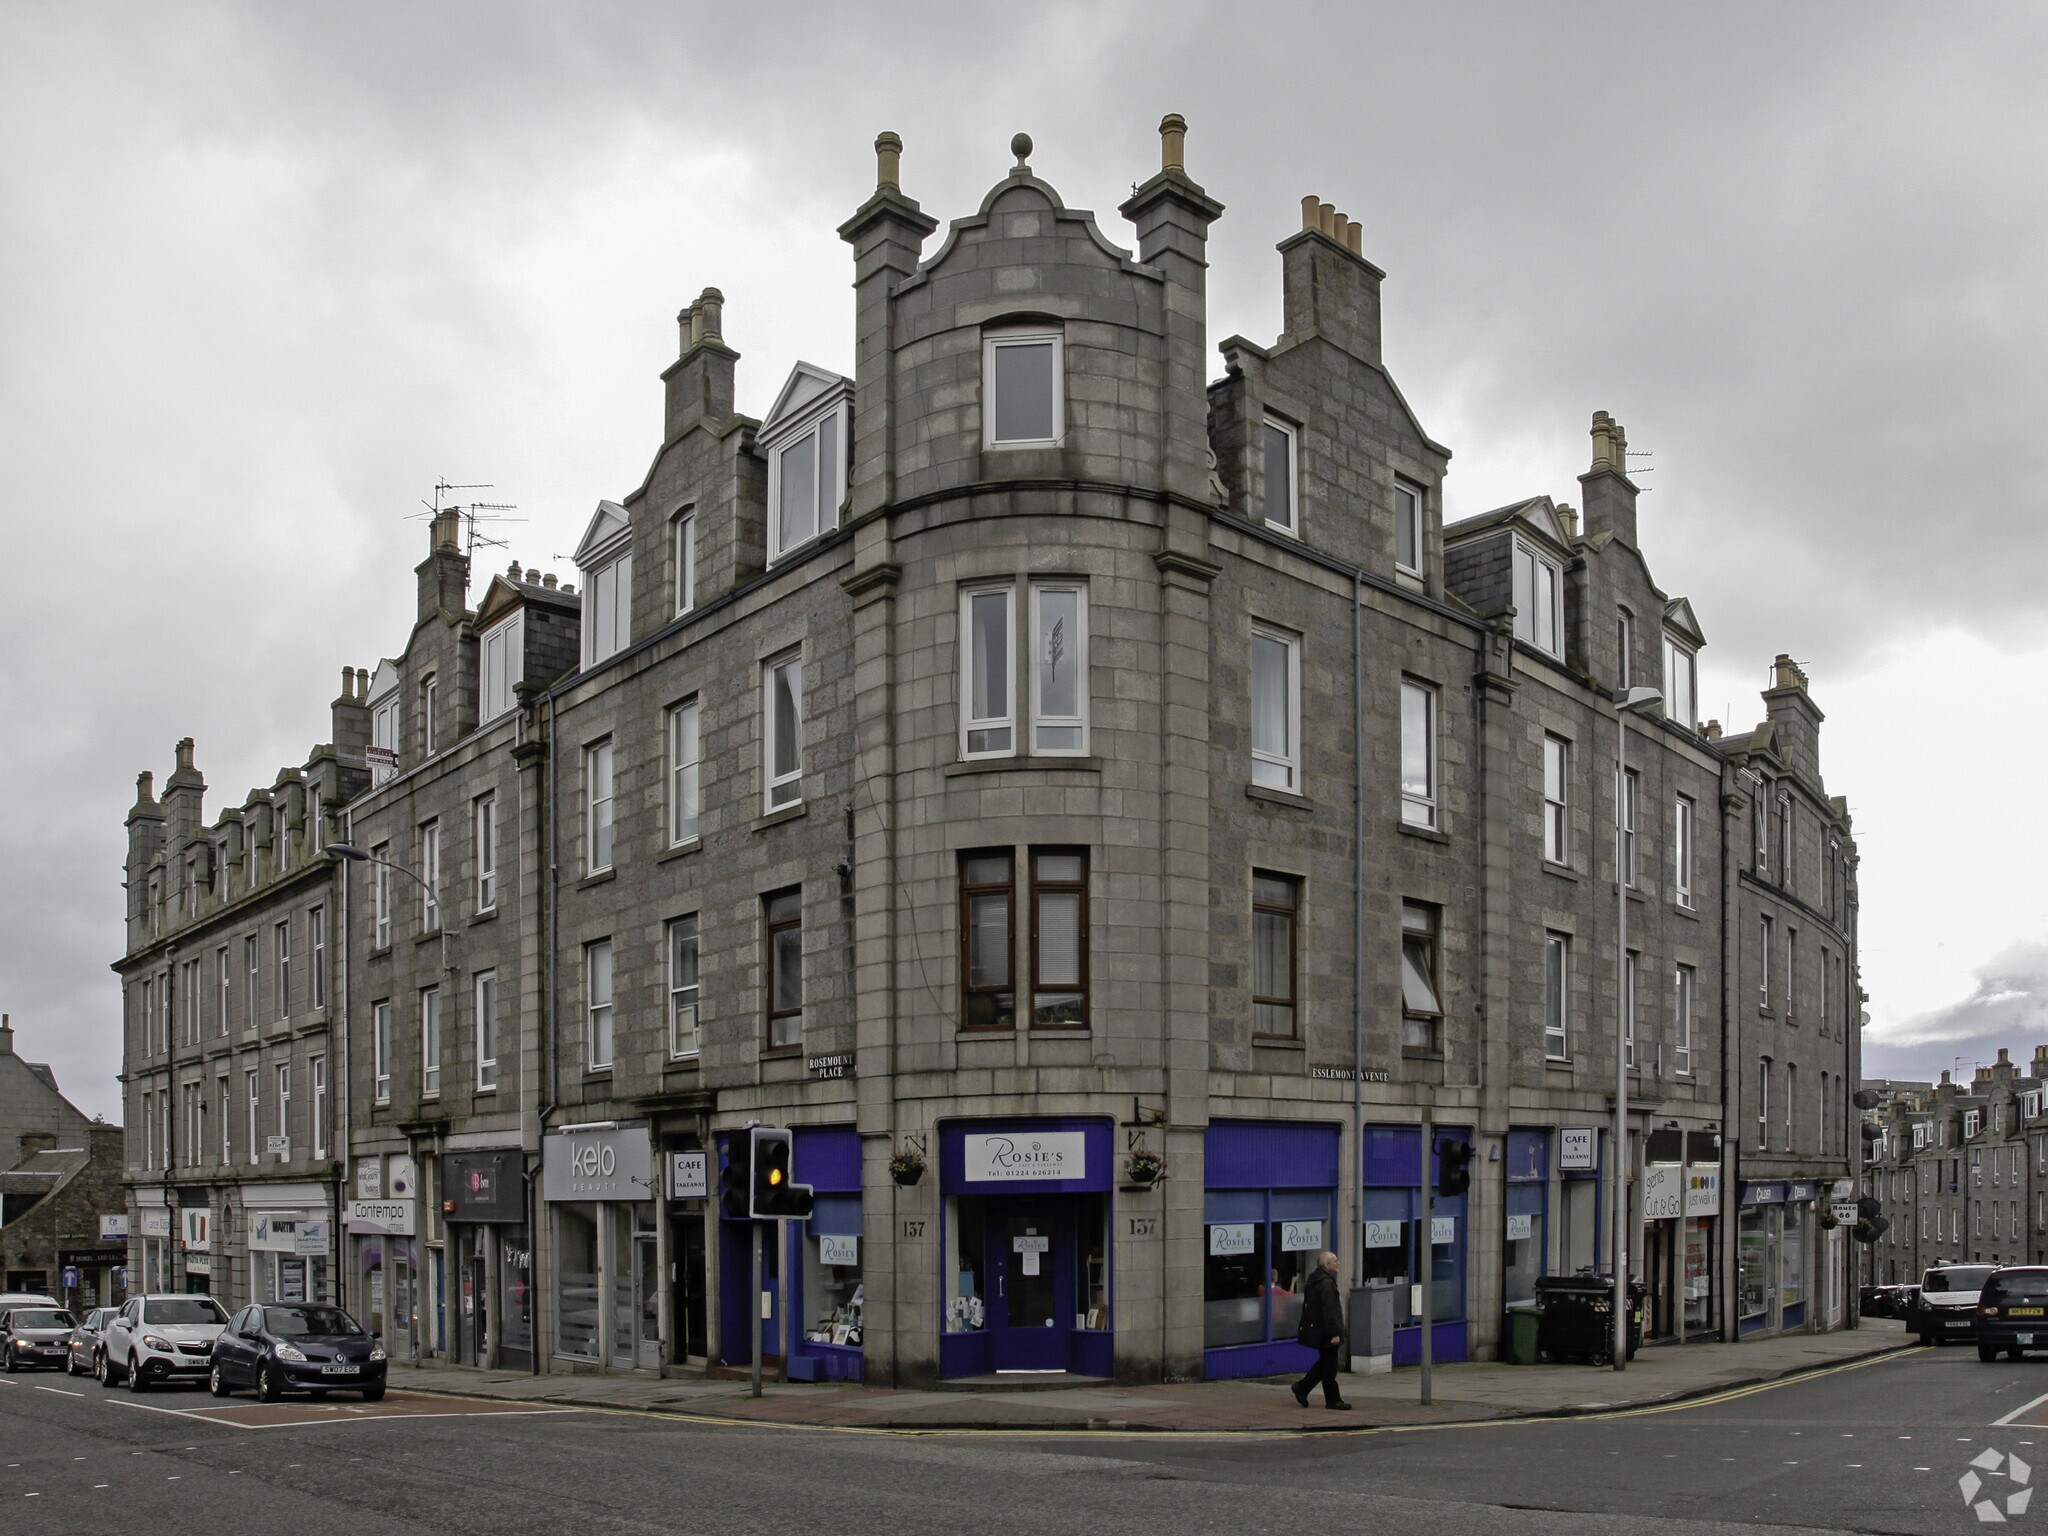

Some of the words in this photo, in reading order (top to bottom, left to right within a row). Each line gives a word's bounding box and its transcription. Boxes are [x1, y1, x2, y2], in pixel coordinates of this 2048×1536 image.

[809, 1054, 854, 1069] ROSEMOUNT
[819, 1066, 843, 1078] PLACE
[1312, 1068, 1356, 1079] ESSLEMONT
[1360, 1071, 1389, 1082] AVENUE
[571, 1141, 616, 1176] kelo
[678, 1161, 702, 1169] CAFE
[573, 1183, 617, 1191] BEAUTY
[1646, 1169, 1664, 1194] gents
[355, 1203, 404, 1220] Contempo
[1645, 1196, 1658, 1216] Cut
[1660, 1198, 1666, 1215] &
[1668, 1195, 1680, 1215] Go
[903, 1221, 926, 1237] 137
[1129, 1218, 1157, 1235] 137
